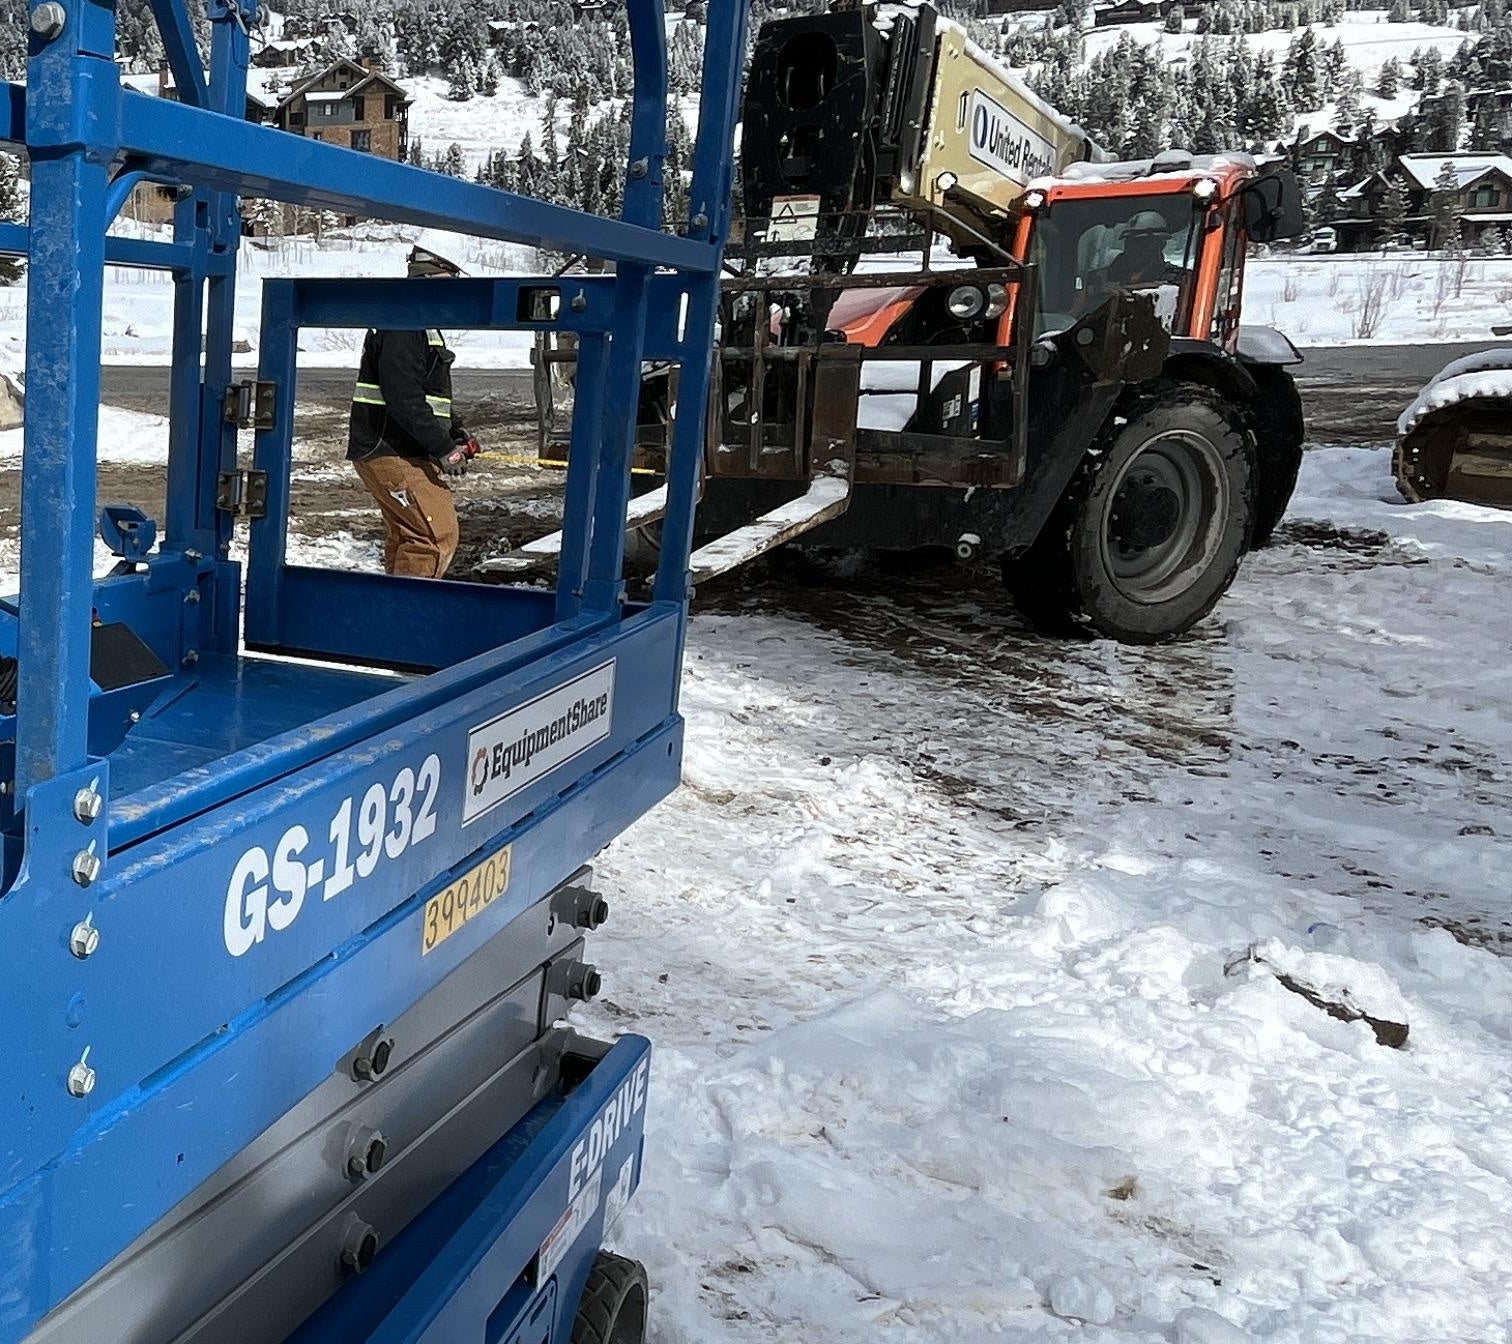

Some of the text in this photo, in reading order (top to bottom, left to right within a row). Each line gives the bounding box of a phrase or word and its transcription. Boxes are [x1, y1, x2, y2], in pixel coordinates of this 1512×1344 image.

[989, 115, 1022, 168] United
[490, 689, 609, 780] EquipmentShare
[223, 753, 441, 957] GS-1932
[425, 850, 510, 950] 399403
